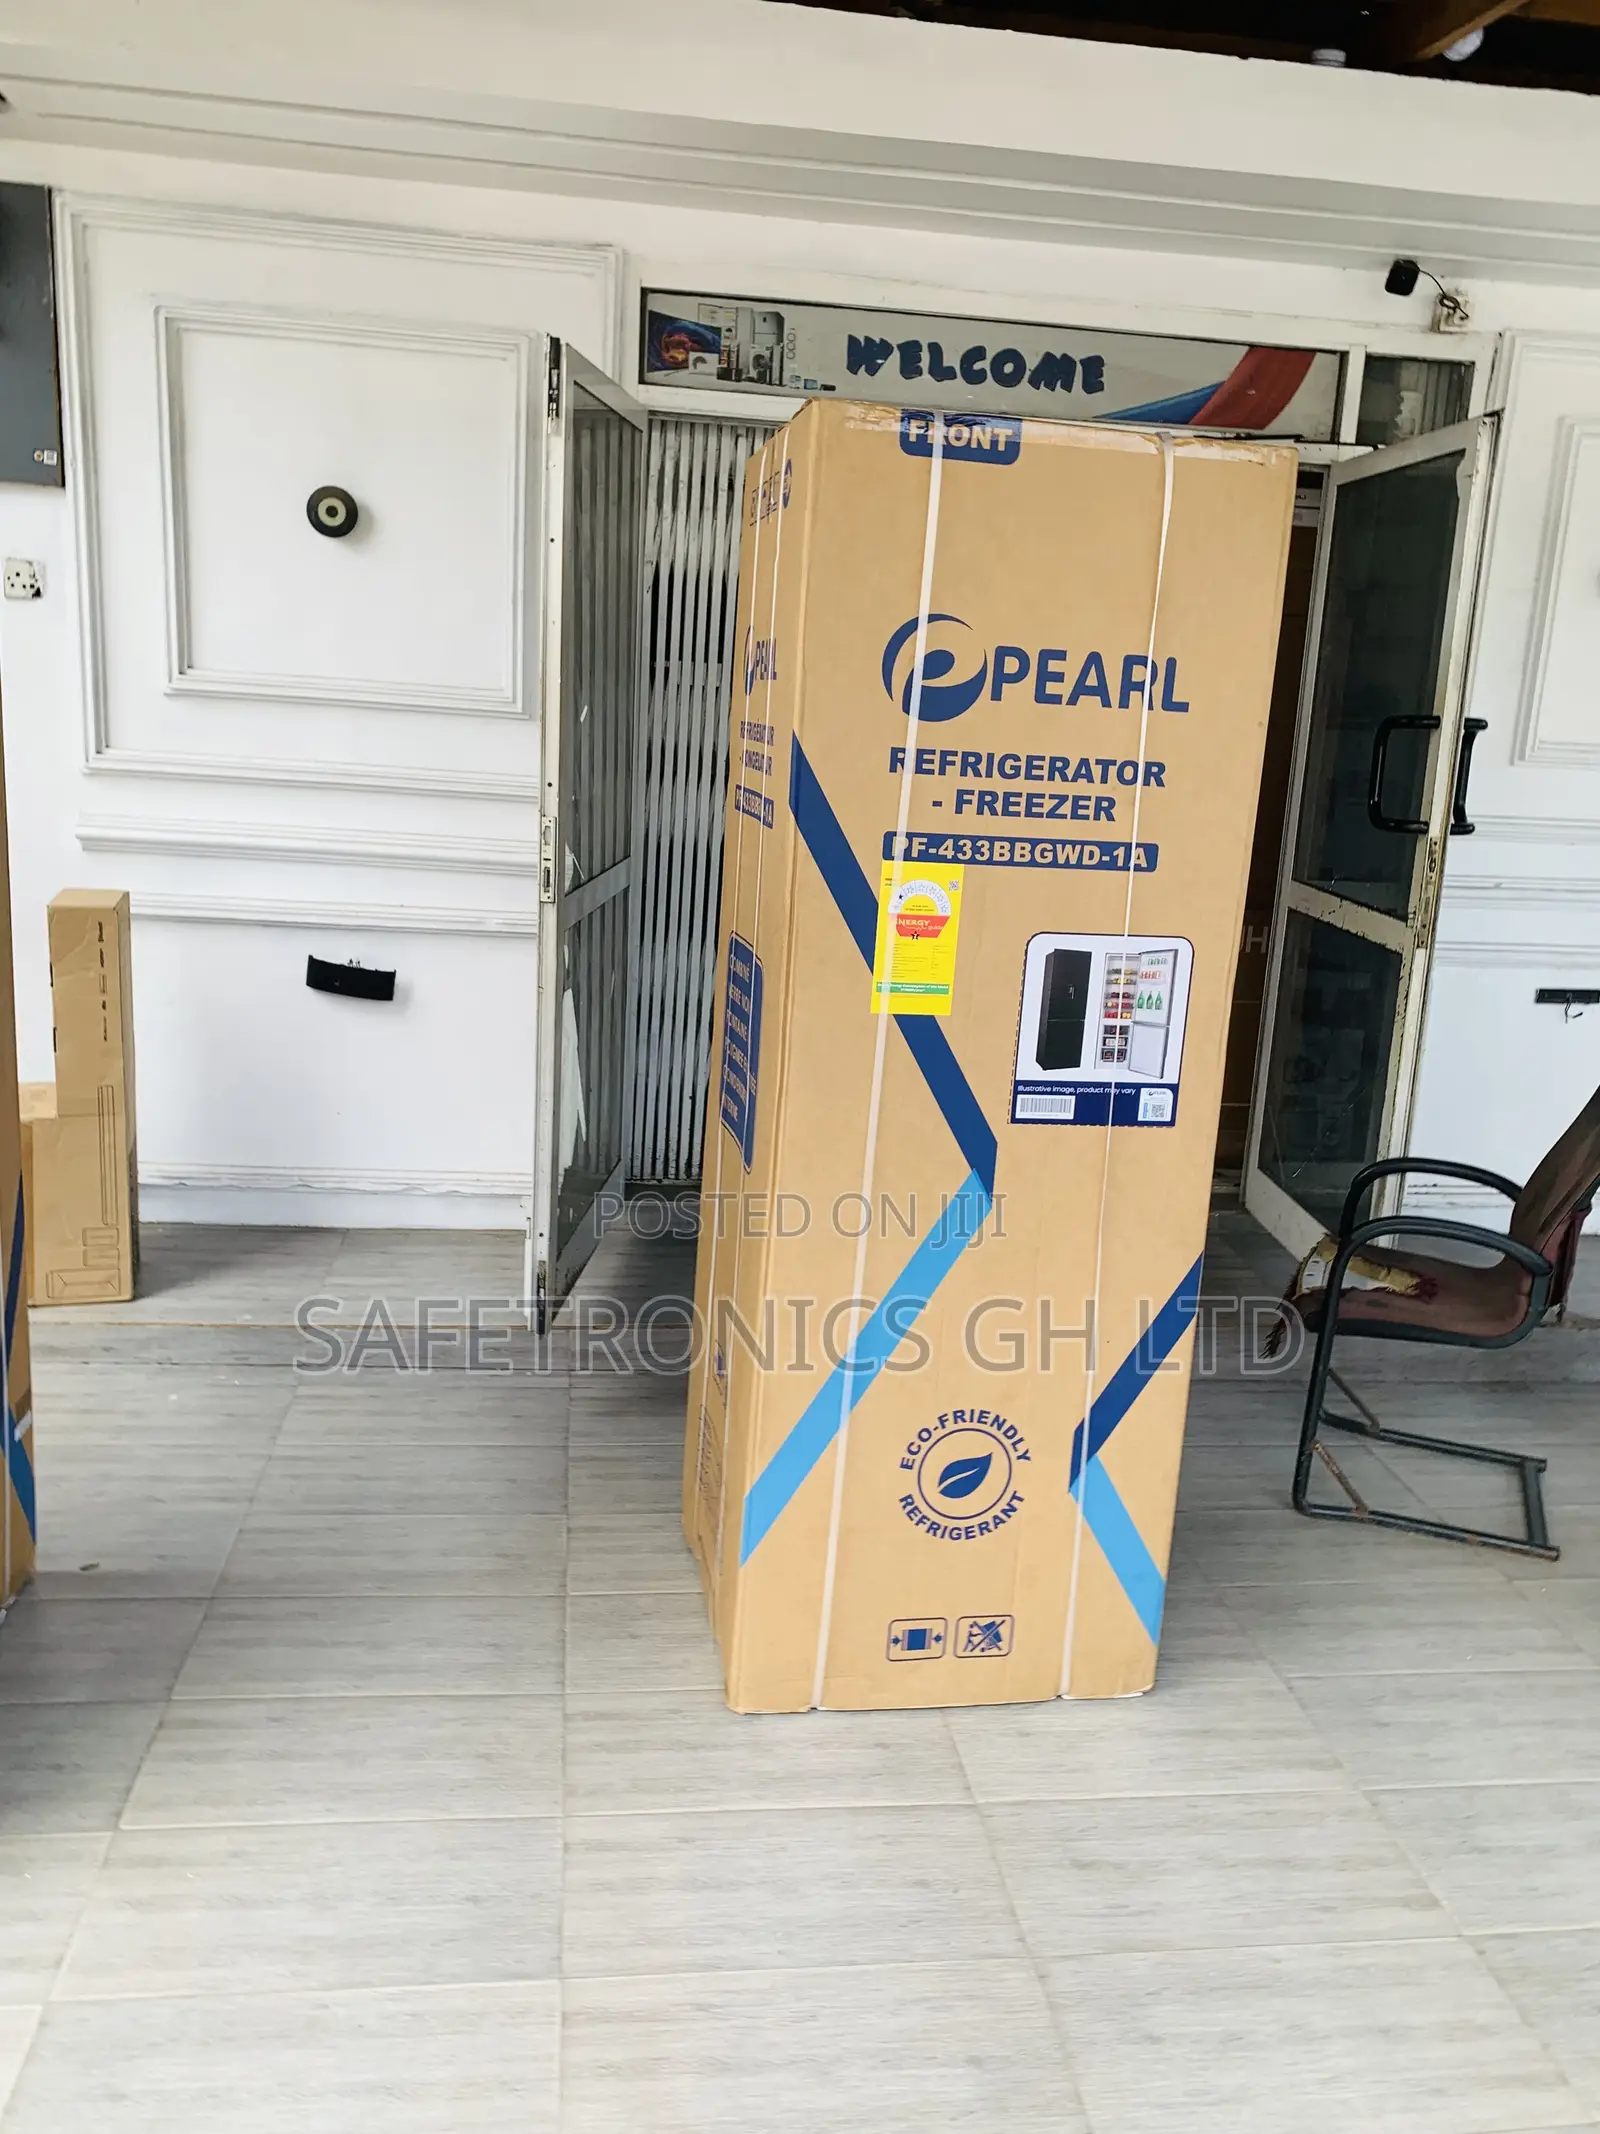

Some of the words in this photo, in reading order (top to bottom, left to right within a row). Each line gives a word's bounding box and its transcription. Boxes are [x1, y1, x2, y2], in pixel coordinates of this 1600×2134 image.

[846, 333, 1106, 394] WELCOME
[990, 645, 1190, 713] PEARL
[889, 747, 1167, 787] REFRIGERATOR
[955, 789, 1116, 822] FREEZER
[891, 836, 1149, 869] PF-433BBGWD-1A
[896, 917, 930, 926] NERGY
[1017, 1085, 1052, 1093] Illustrative
[1076, 1087, 1104, 1095] product
[1120, 1088, 1137, 1096] vary
[899, 1408, 1032, 1471] ECO-FRIENDLY
[898, 1489, 1026, 1541] REFRIGERANT
